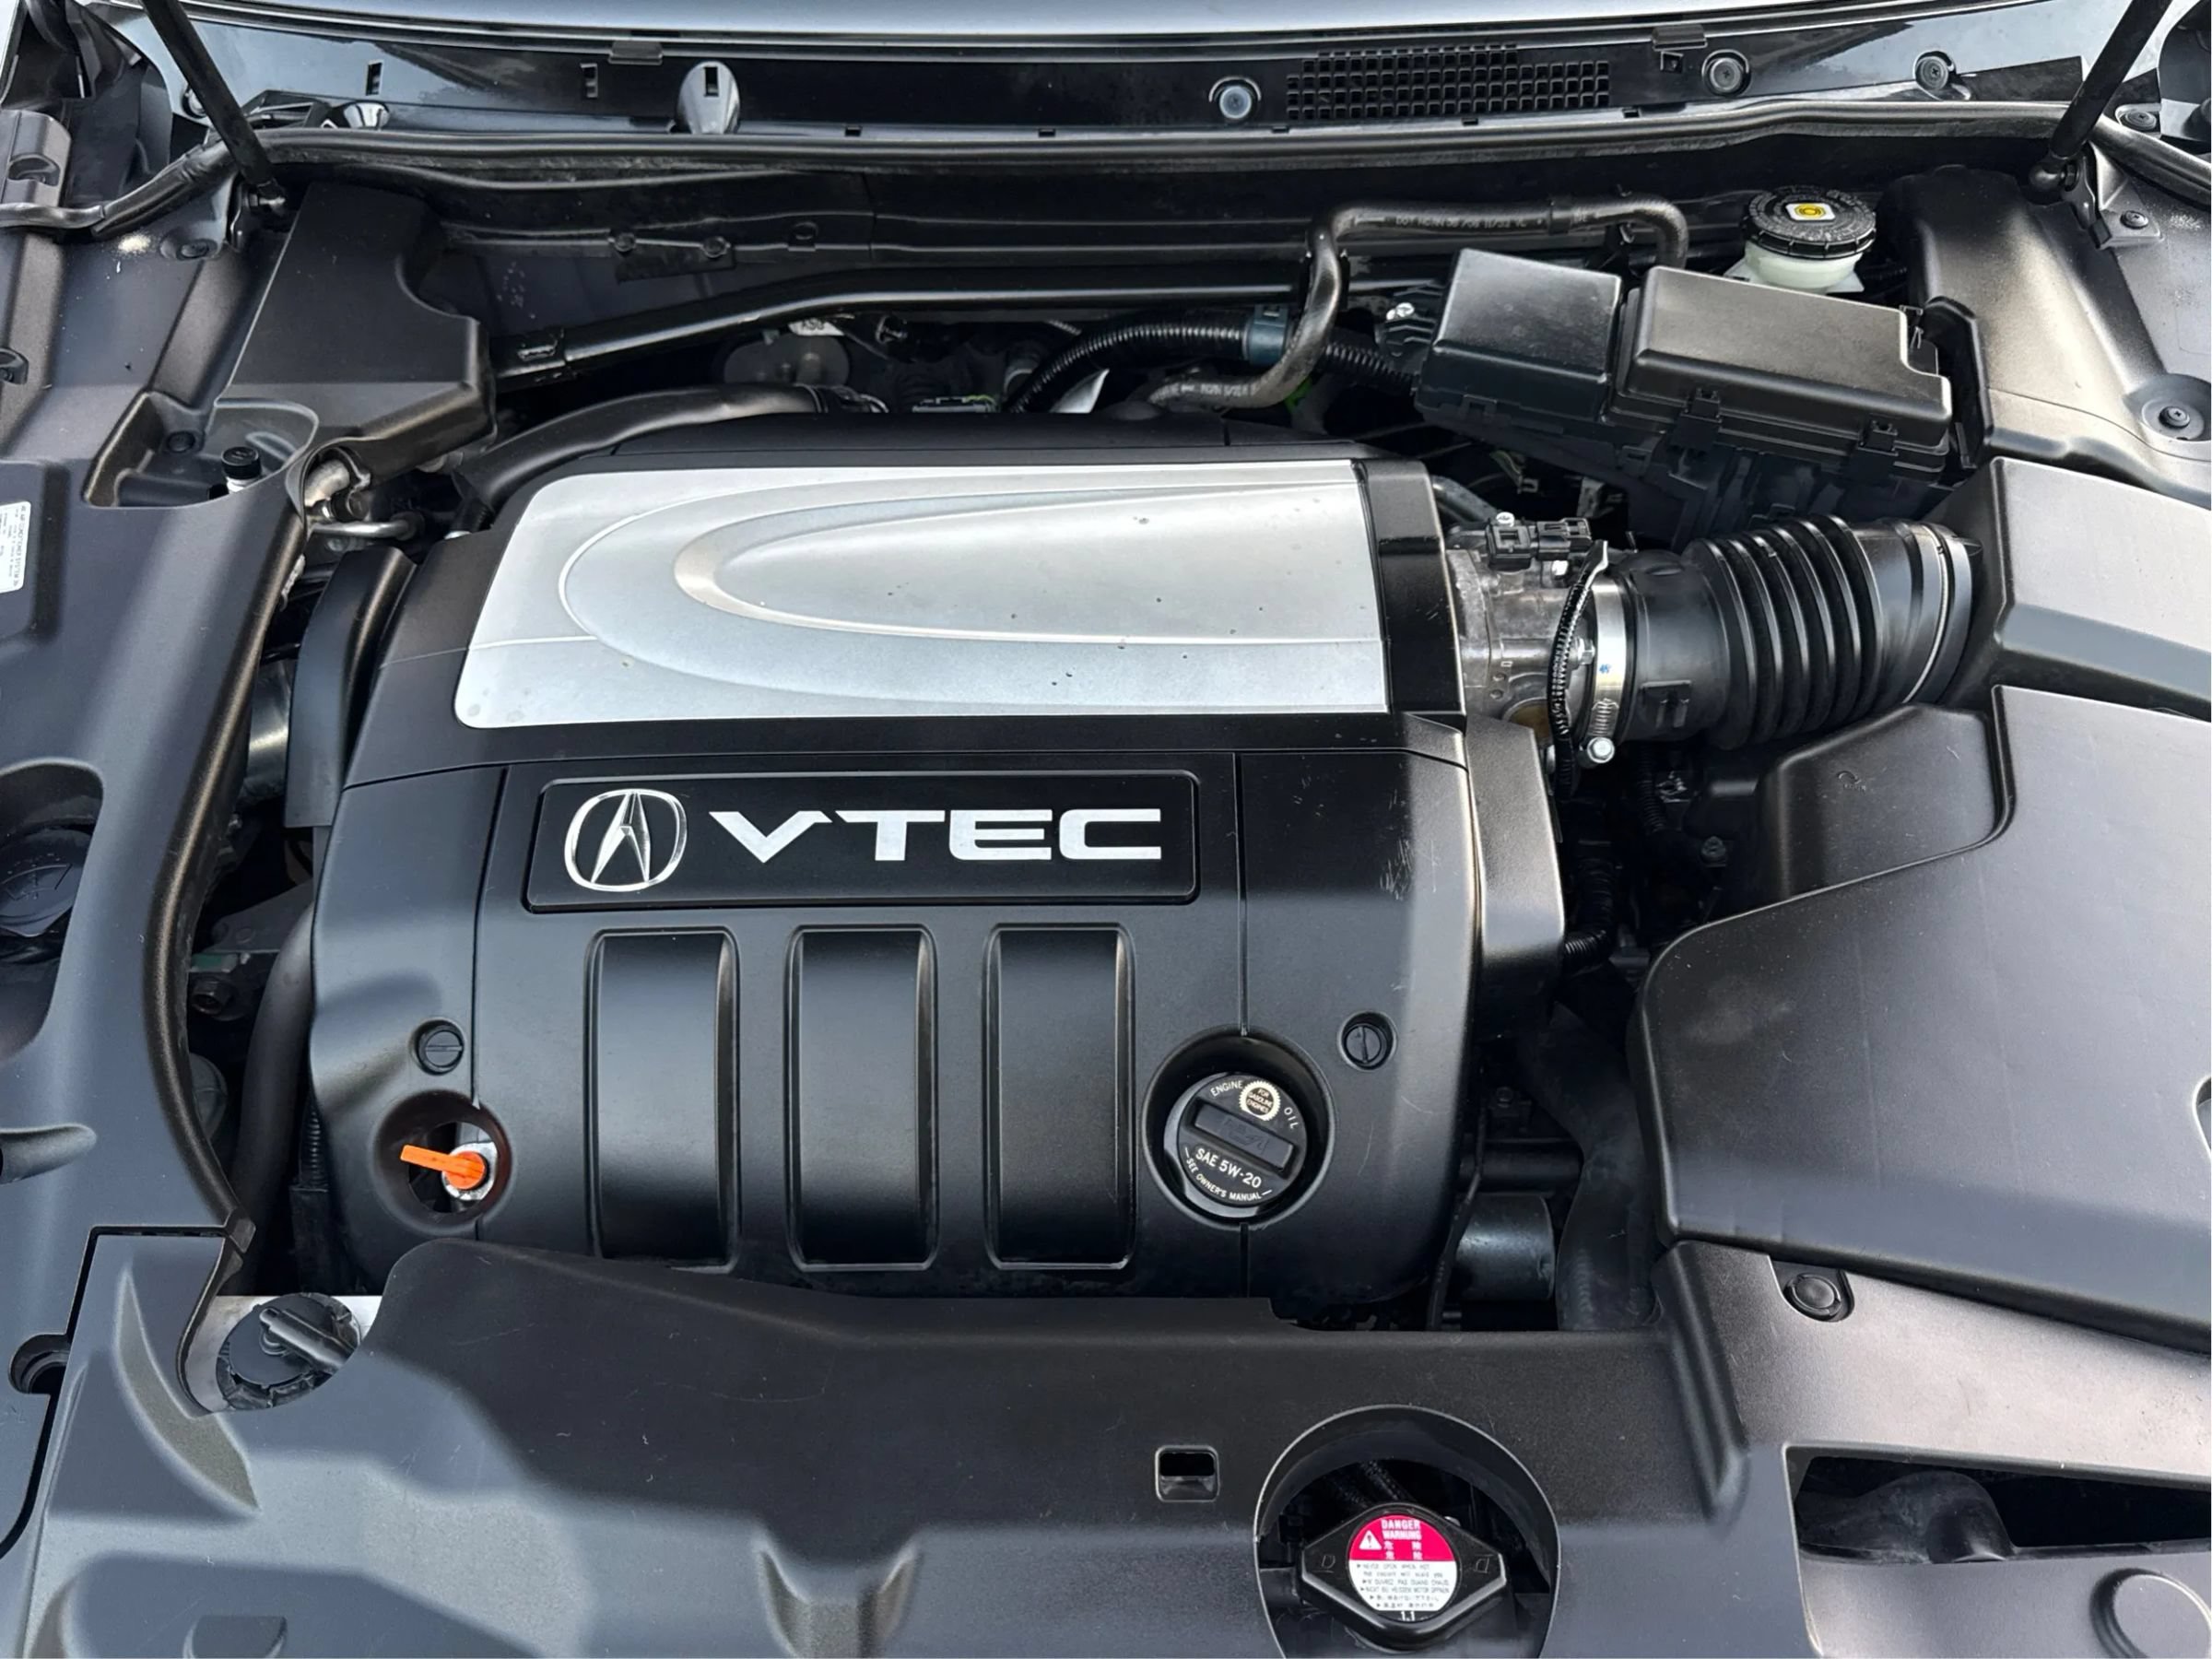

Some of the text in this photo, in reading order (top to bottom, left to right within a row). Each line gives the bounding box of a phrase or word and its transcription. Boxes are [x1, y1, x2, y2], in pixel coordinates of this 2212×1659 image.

[709, 808, 1161, 863] VTEC
[1210, 1080, 1243, 1097] ENGINE
[1284, 1107, 1299, 1129] OIL
[1186, 1158, 1262, 1202] SEE OWNER'S MANUAL
[1195, 1147, 1262, 1188] SAE 5W-20
[1381, 1518, 1420, 1530] DANGER
